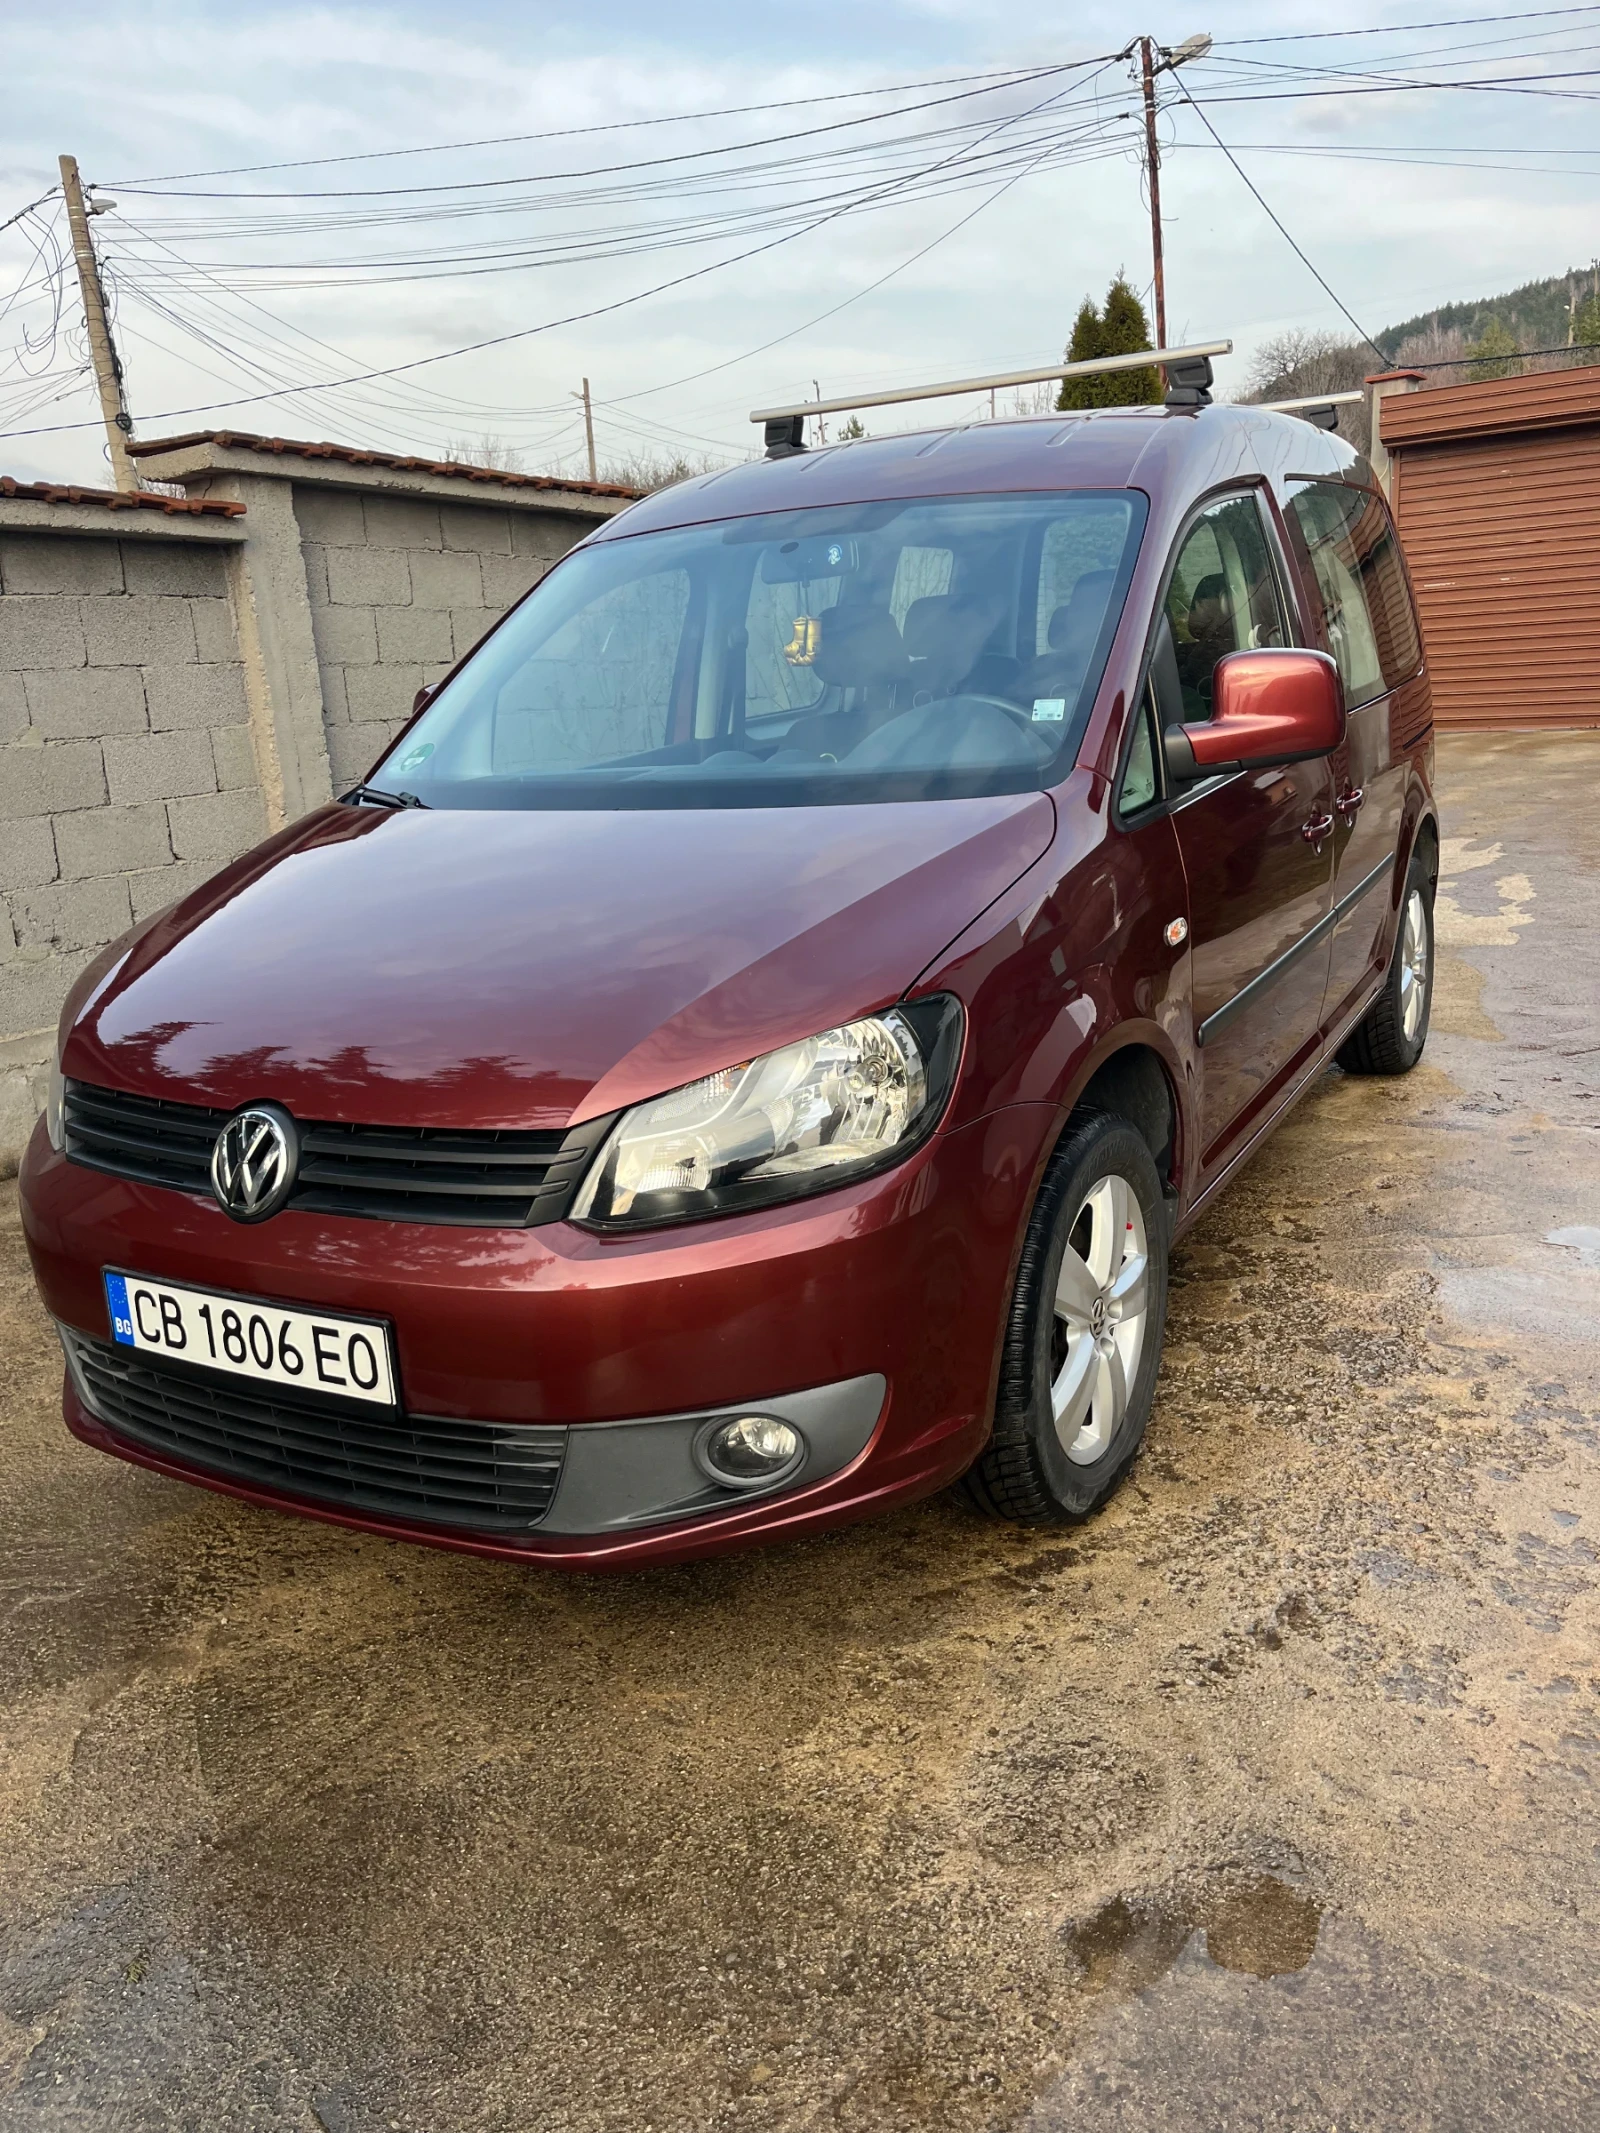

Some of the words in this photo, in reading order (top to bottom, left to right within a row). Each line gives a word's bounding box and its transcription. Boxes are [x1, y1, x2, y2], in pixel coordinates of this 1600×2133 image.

[214, 1110, 284, 1215] VW
[114, 1316, 132, 1335] BG
[134, 1289, 188, 1350] CB
[198, 1303, 303, 1376] 1806
